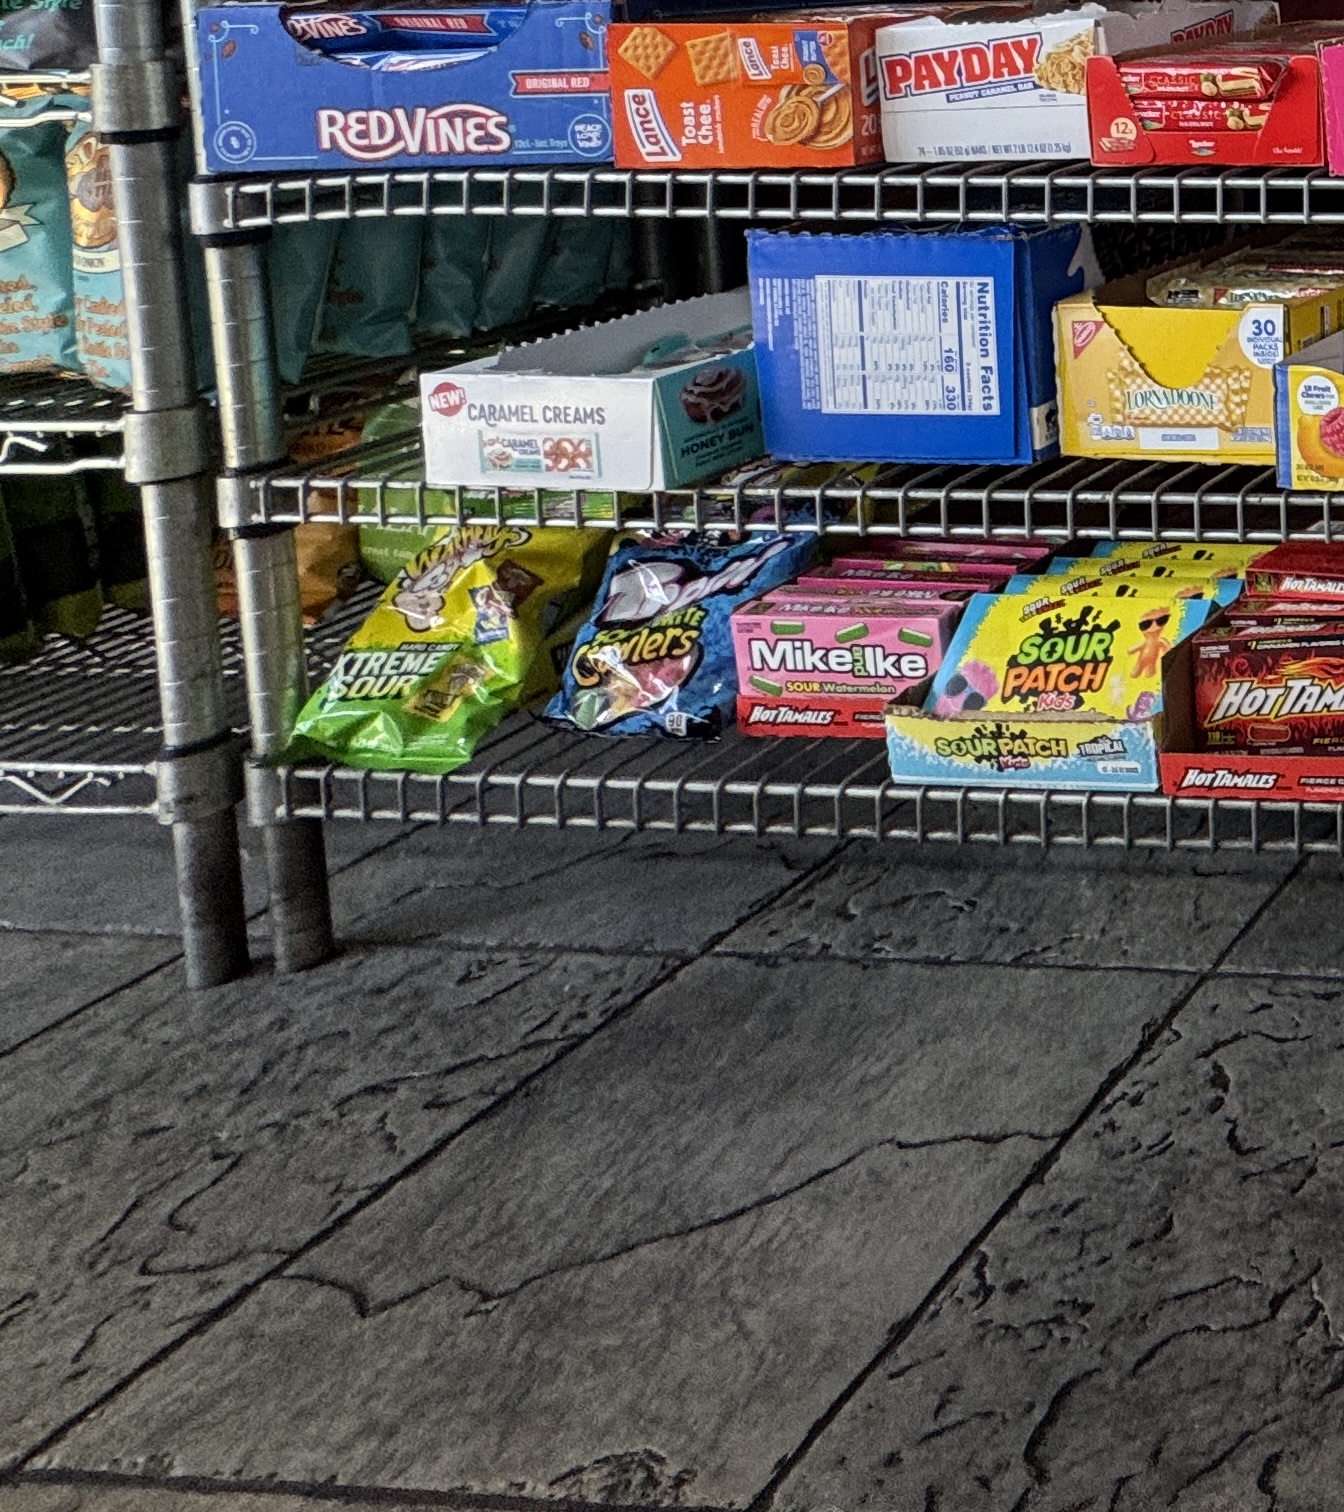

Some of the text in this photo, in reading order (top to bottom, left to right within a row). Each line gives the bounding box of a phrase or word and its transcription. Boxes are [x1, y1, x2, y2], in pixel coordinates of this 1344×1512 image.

[884, 36, 1041, 96] PAYDAY
[638, 93, 668, 157] Lance
[681, 102, 697, 146] Toast
[1252, 320, 1276, 336] 30
[977, 281, 994, 411] Nutrition Facts
[429, 388, 465, 411] NEW!
[468, 403, 606, 426] CARAMEL CREAMS
[681, 433, 724, 457] HONEY
[750, 640, 852, 671] Mike
[1019, 633, 1113, 663] SOUR
[787, 682, 896, 694] SOUR Watermelon
[1003, 663, 1108, 695] PATCH
[1037, 693, 1075, 710] Kids
[936, 739, 1067, 756] SOUR PATCH
